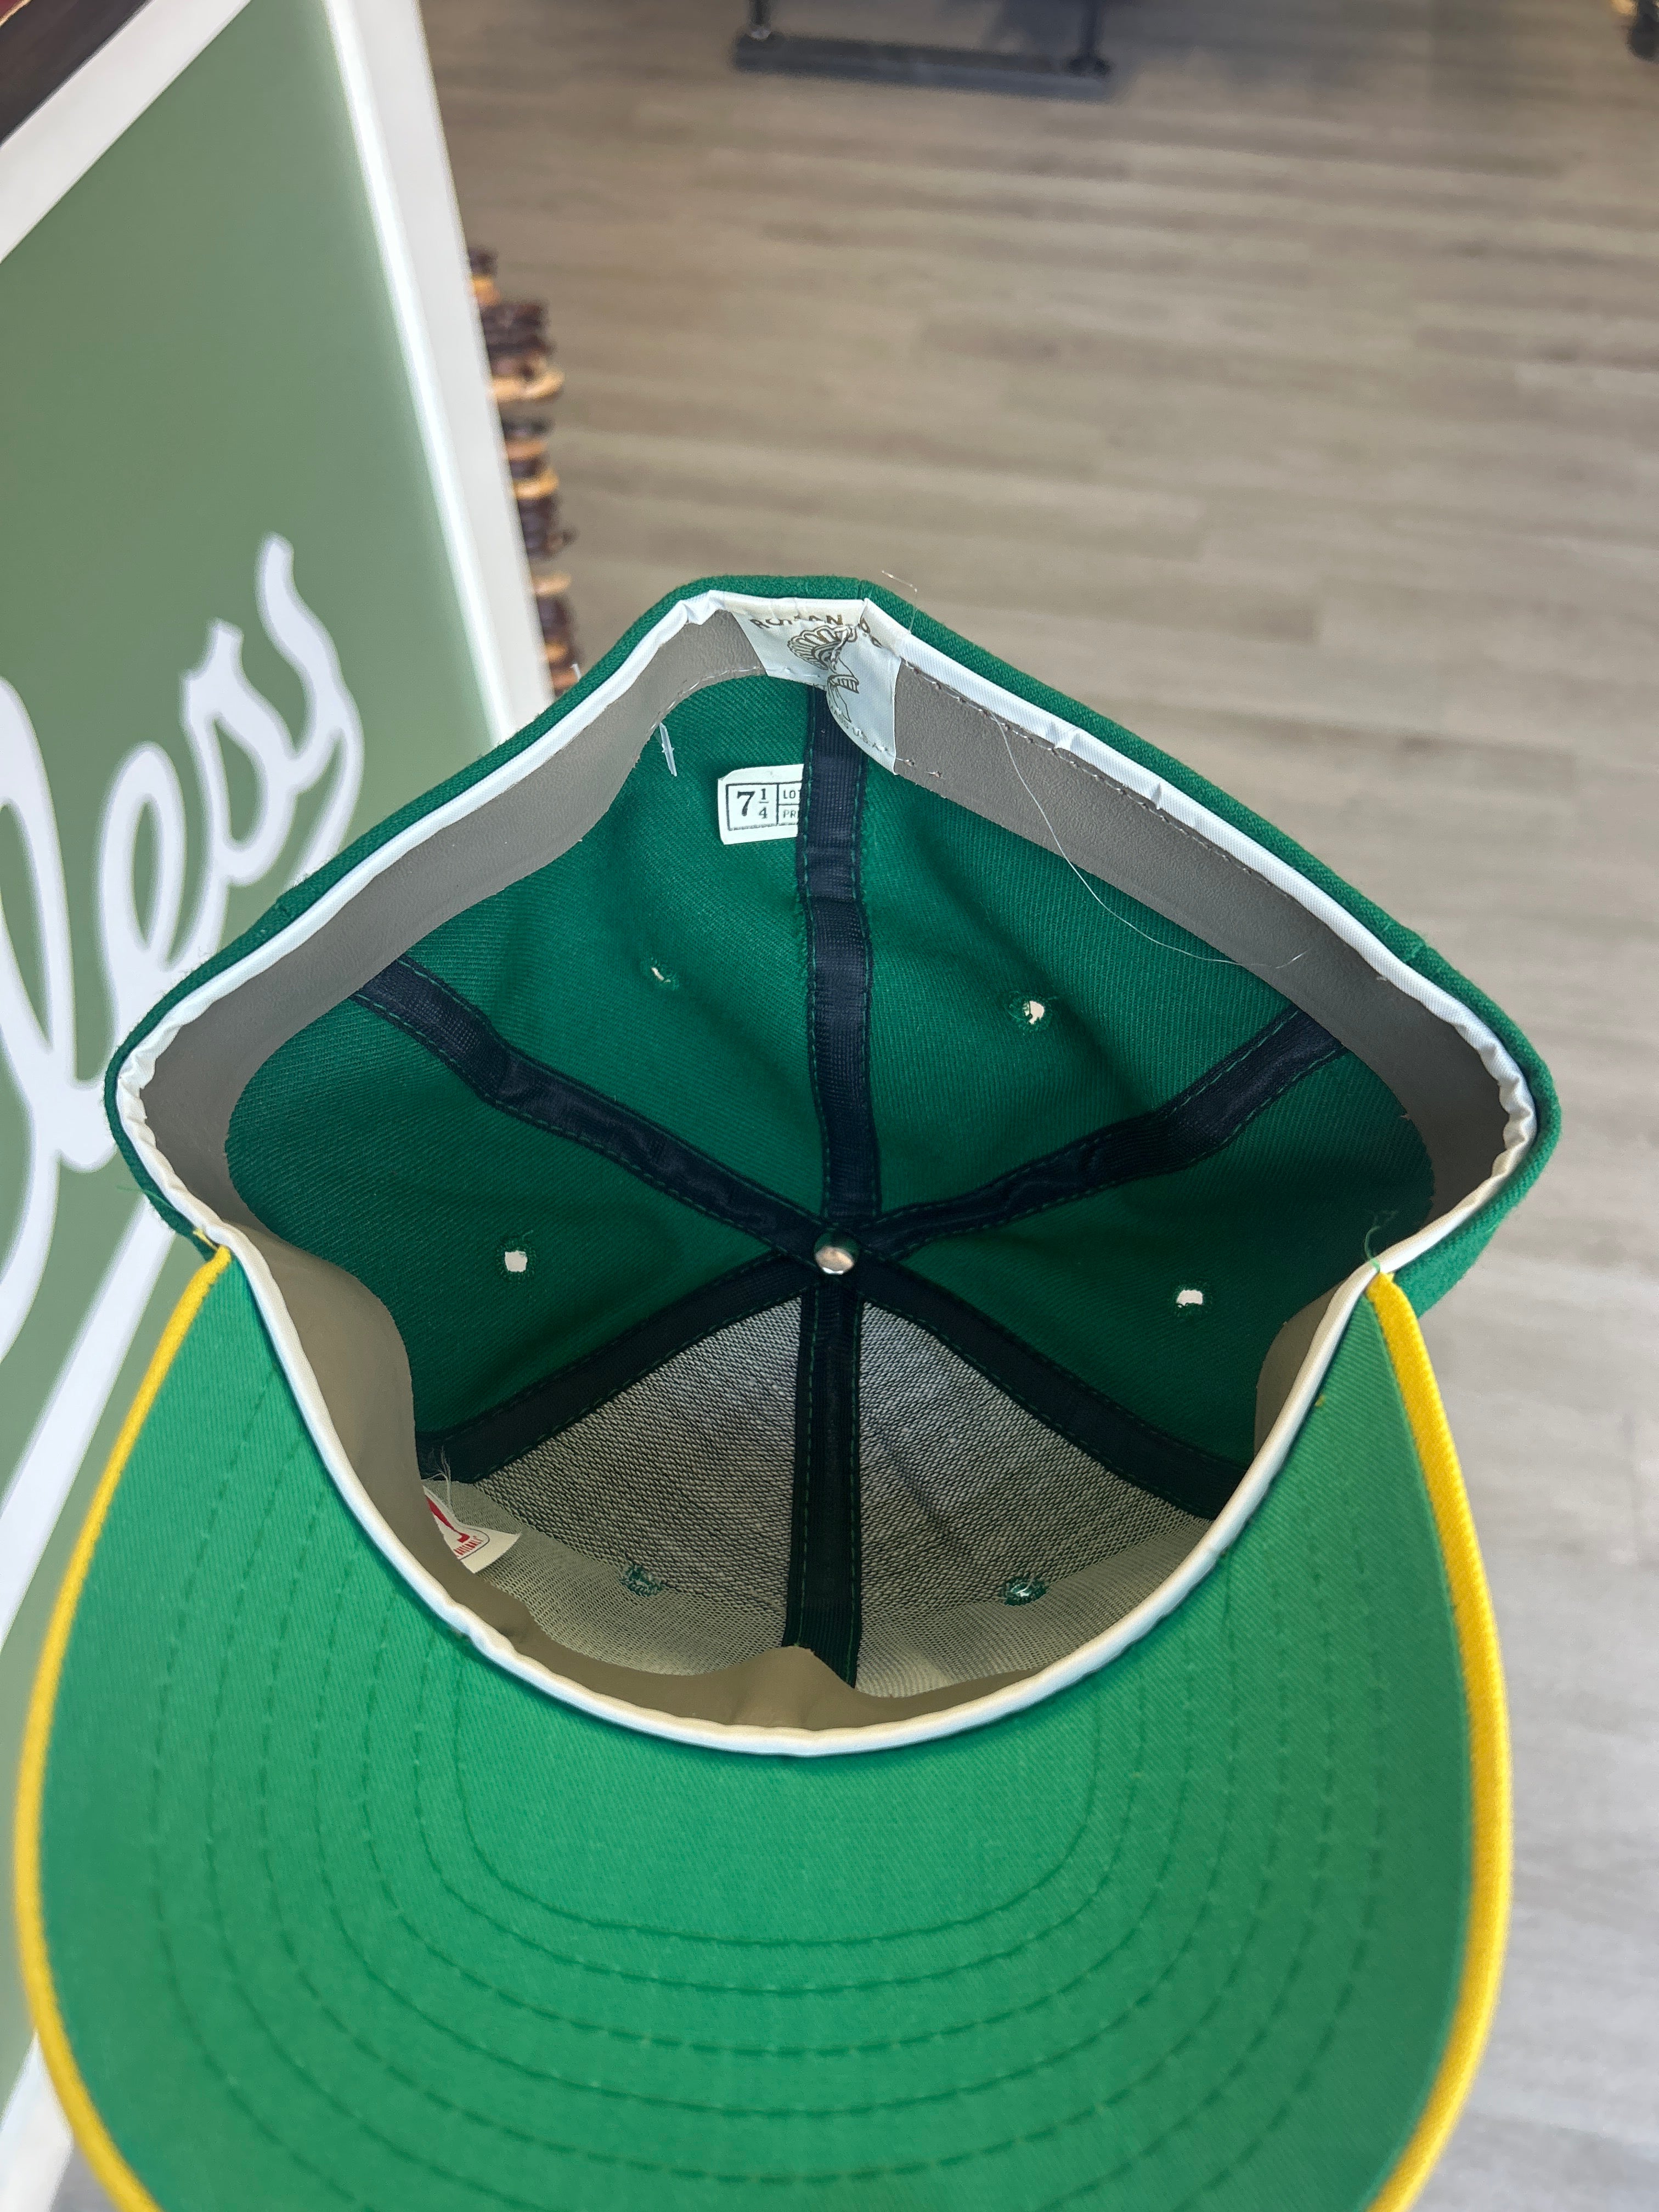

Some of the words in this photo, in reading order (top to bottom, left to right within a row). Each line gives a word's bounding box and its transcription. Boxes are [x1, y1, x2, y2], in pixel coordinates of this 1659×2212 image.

[783, 789, 800, 799] LO
[737, 791, 755, 817] 7
[783, 809, 799, 819] PR
